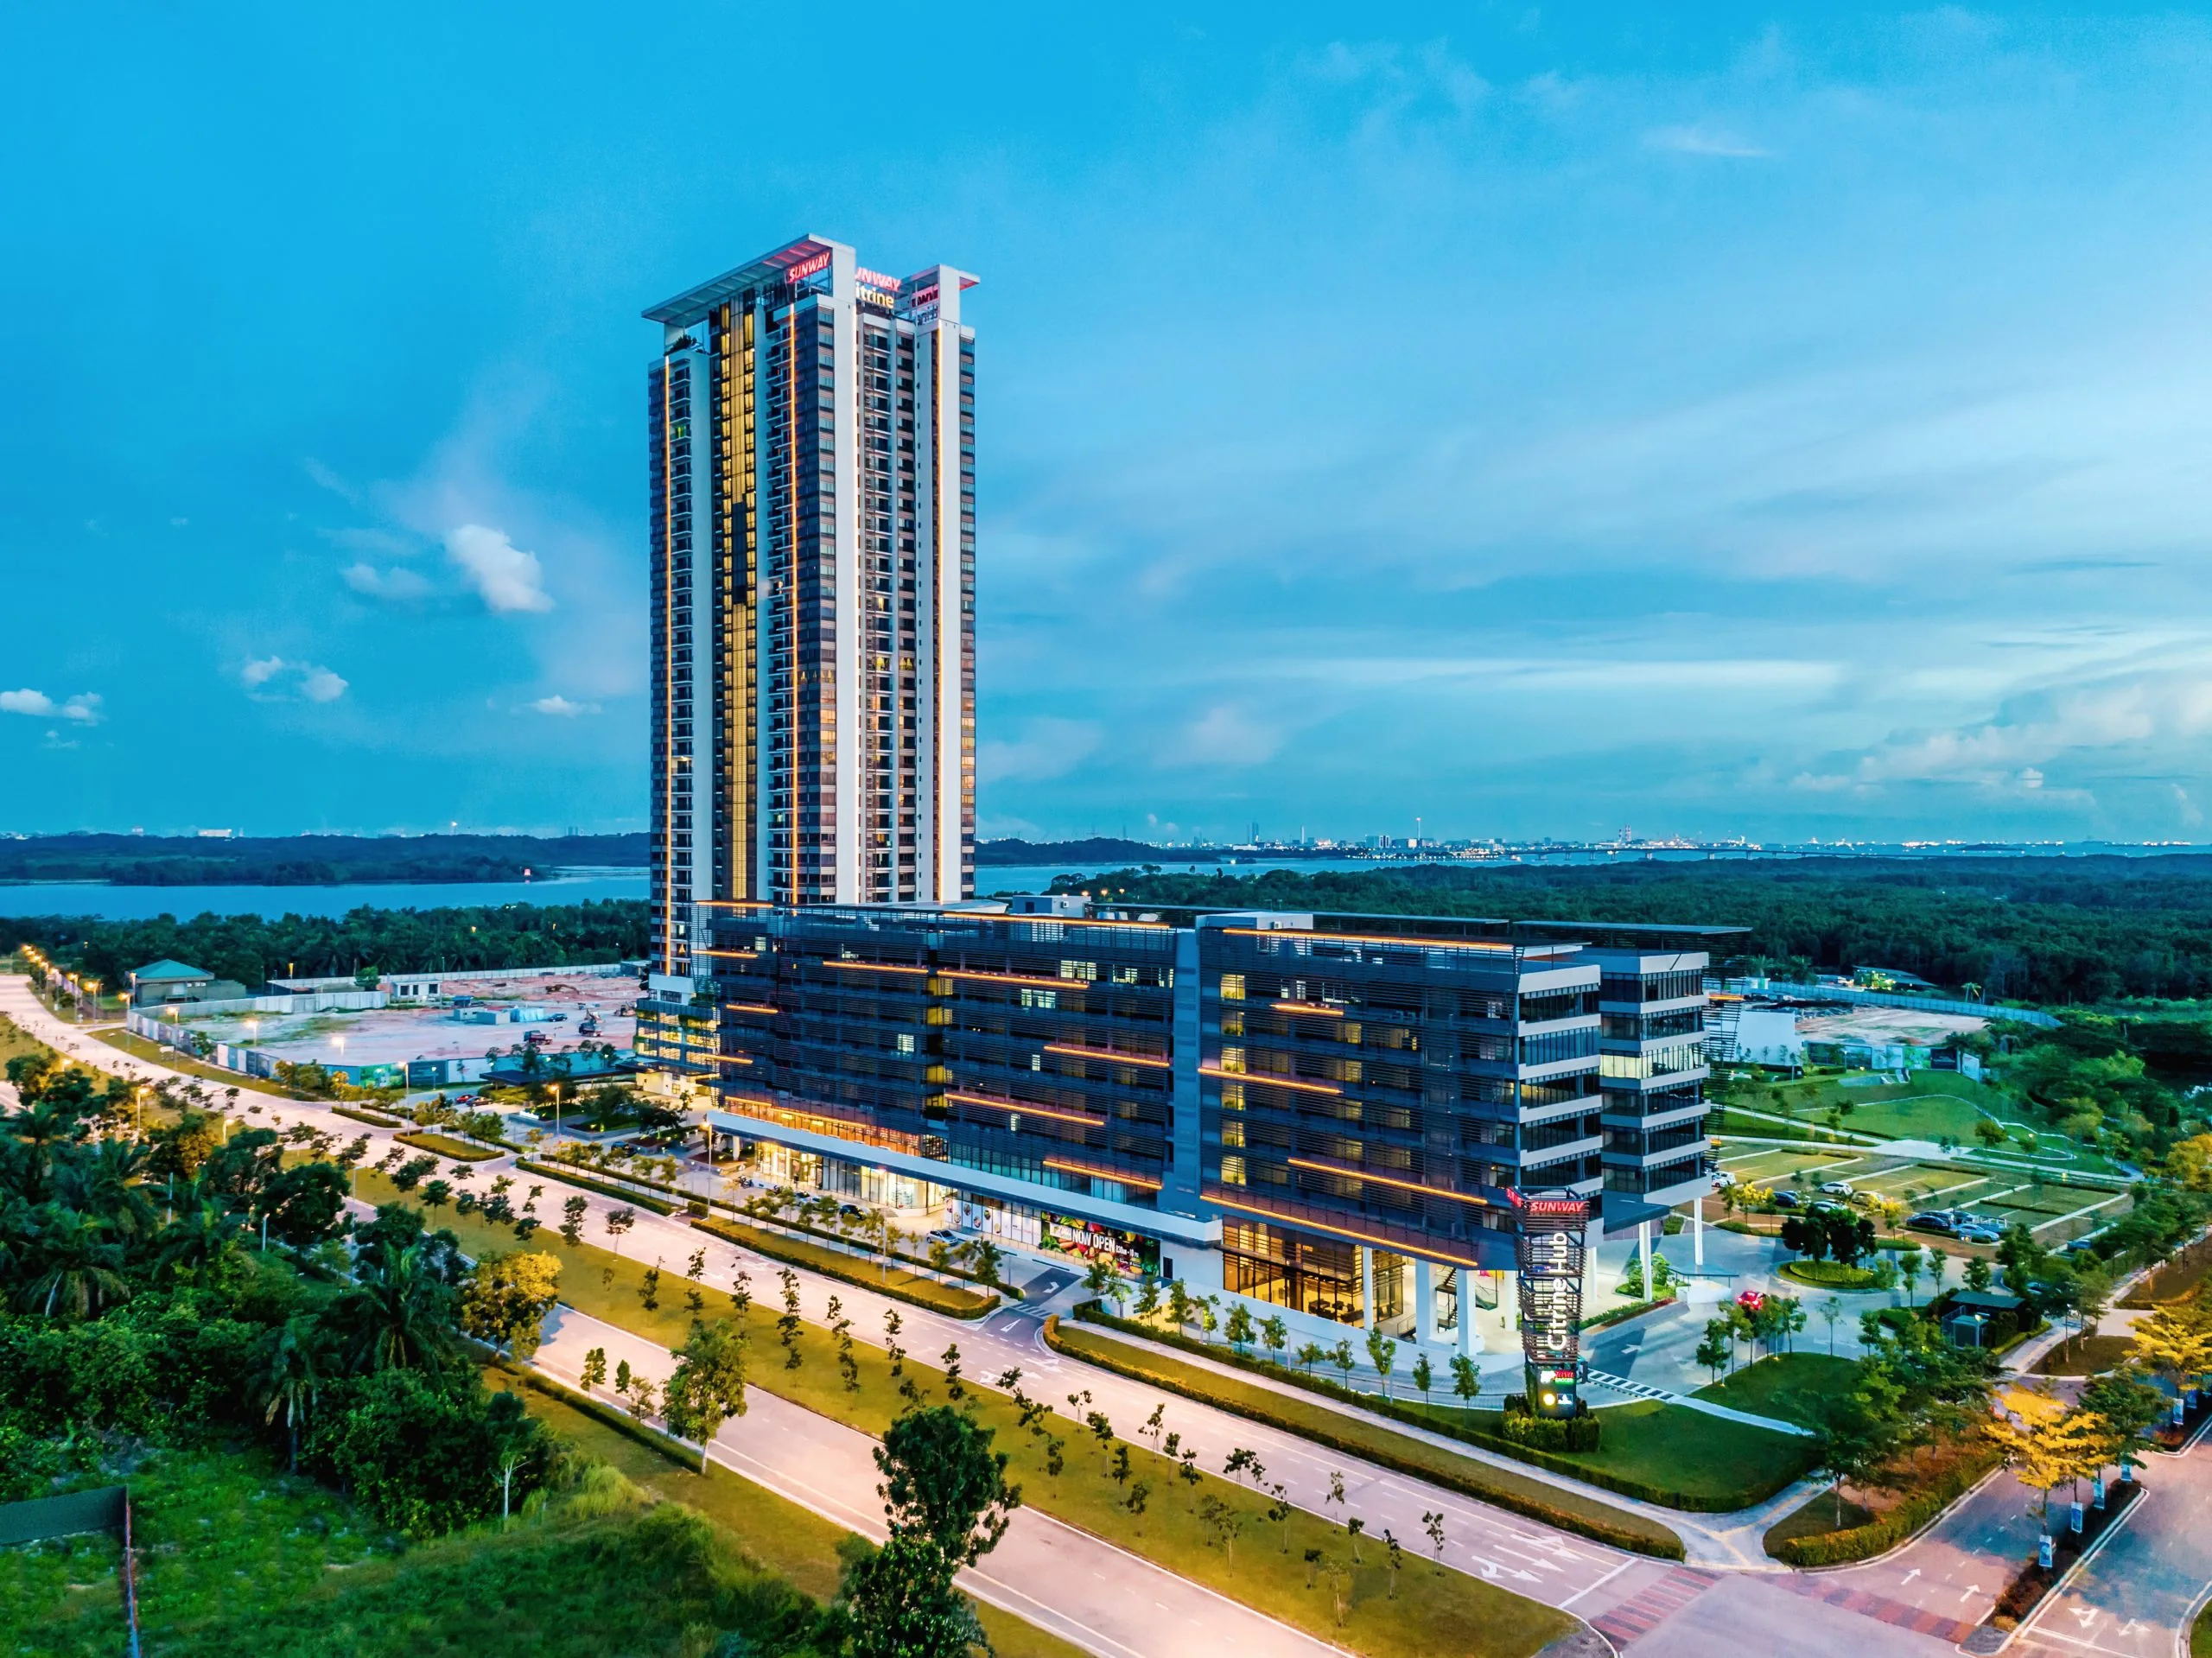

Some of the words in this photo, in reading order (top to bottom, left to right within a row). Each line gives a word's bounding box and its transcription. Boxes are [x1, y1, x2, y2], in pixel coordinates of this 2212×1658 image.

[789, 252, 830, 283] SUNWAY
[855, 267, 901, 292] UNWAY
[855, 282, 894, 309] itrine
[1530, 1201, 1585, 1212] SUNWAY
[1072, 1229, 1091, 1246] NOW
[1093, 1234, 1116, 1253] OPEN
[1548, 1232, 1567, 1274] Hub
[1547, 1278, 1567, 1351] Citrine
